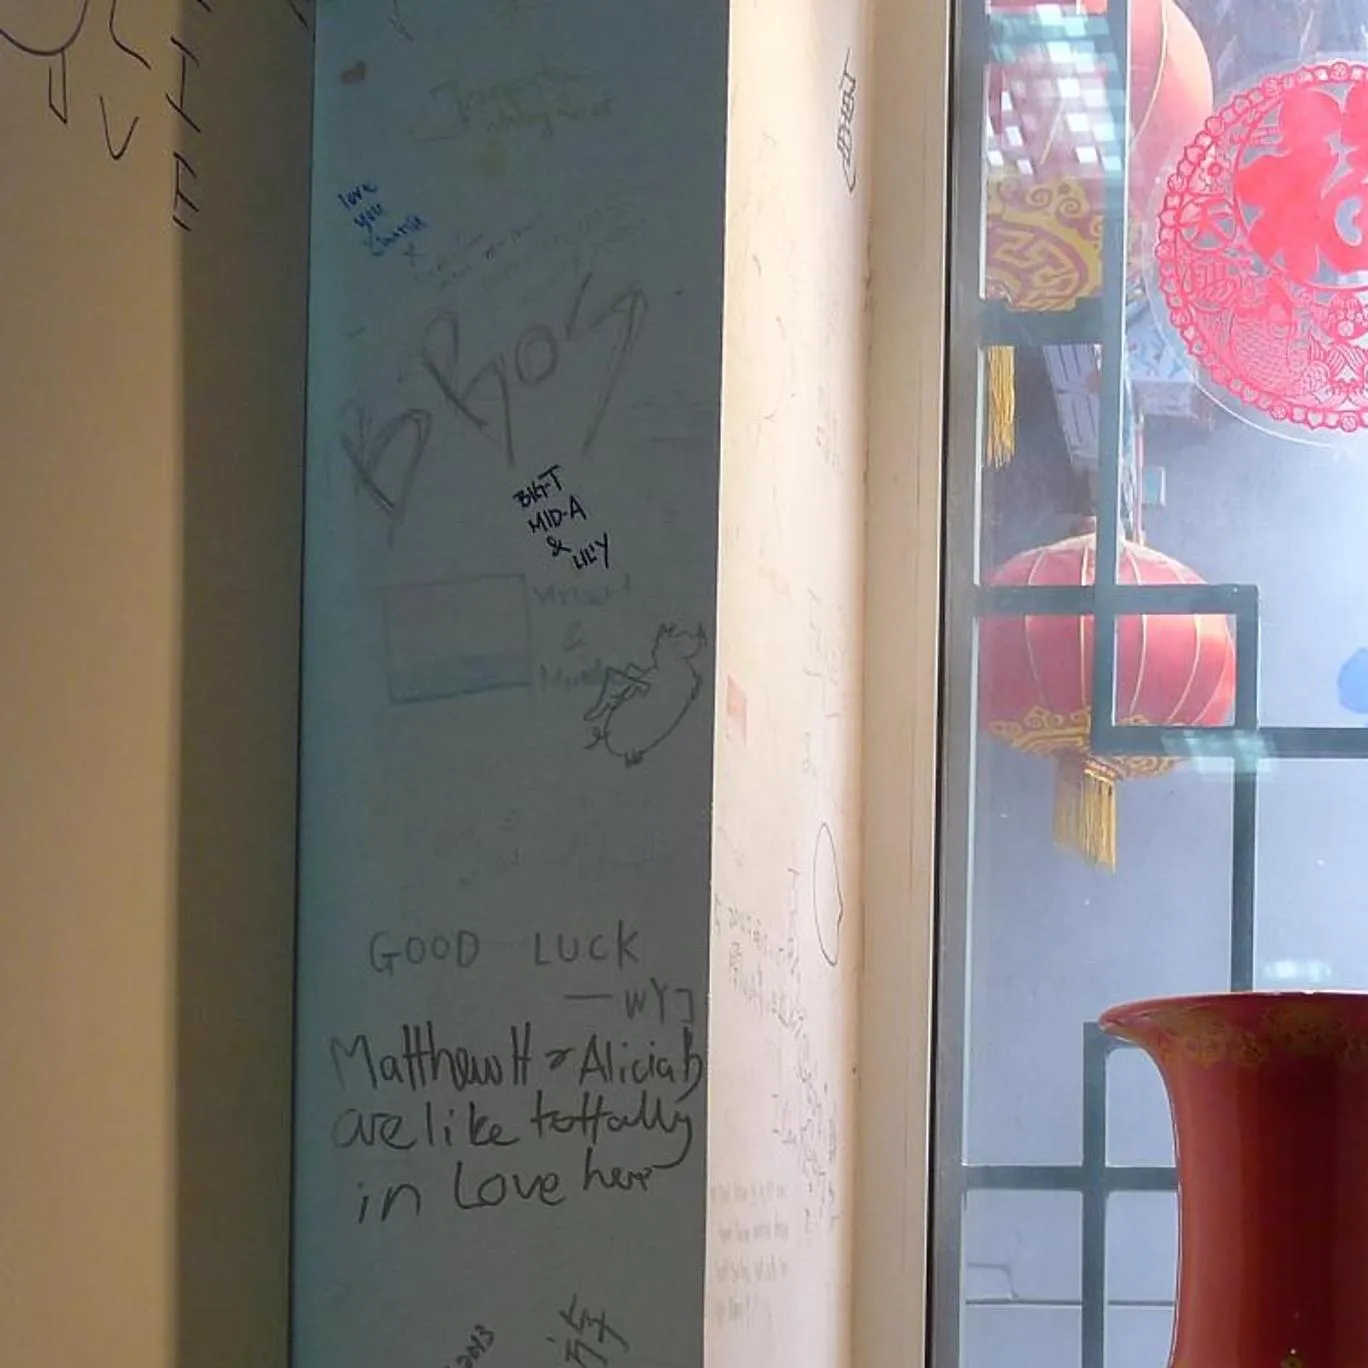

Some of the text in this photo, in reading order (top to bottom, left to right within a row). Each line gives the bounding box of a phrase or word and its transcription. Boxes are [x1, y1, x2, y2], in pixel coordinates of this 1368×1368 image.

[546, 535, 572, 557] &
[369, 919, 640, 976] GOOD LUCK
[333, 1109, 417, 1150] are
[425, 1101, 521, 1146] like
[358, 1182, 422, 1224] in
